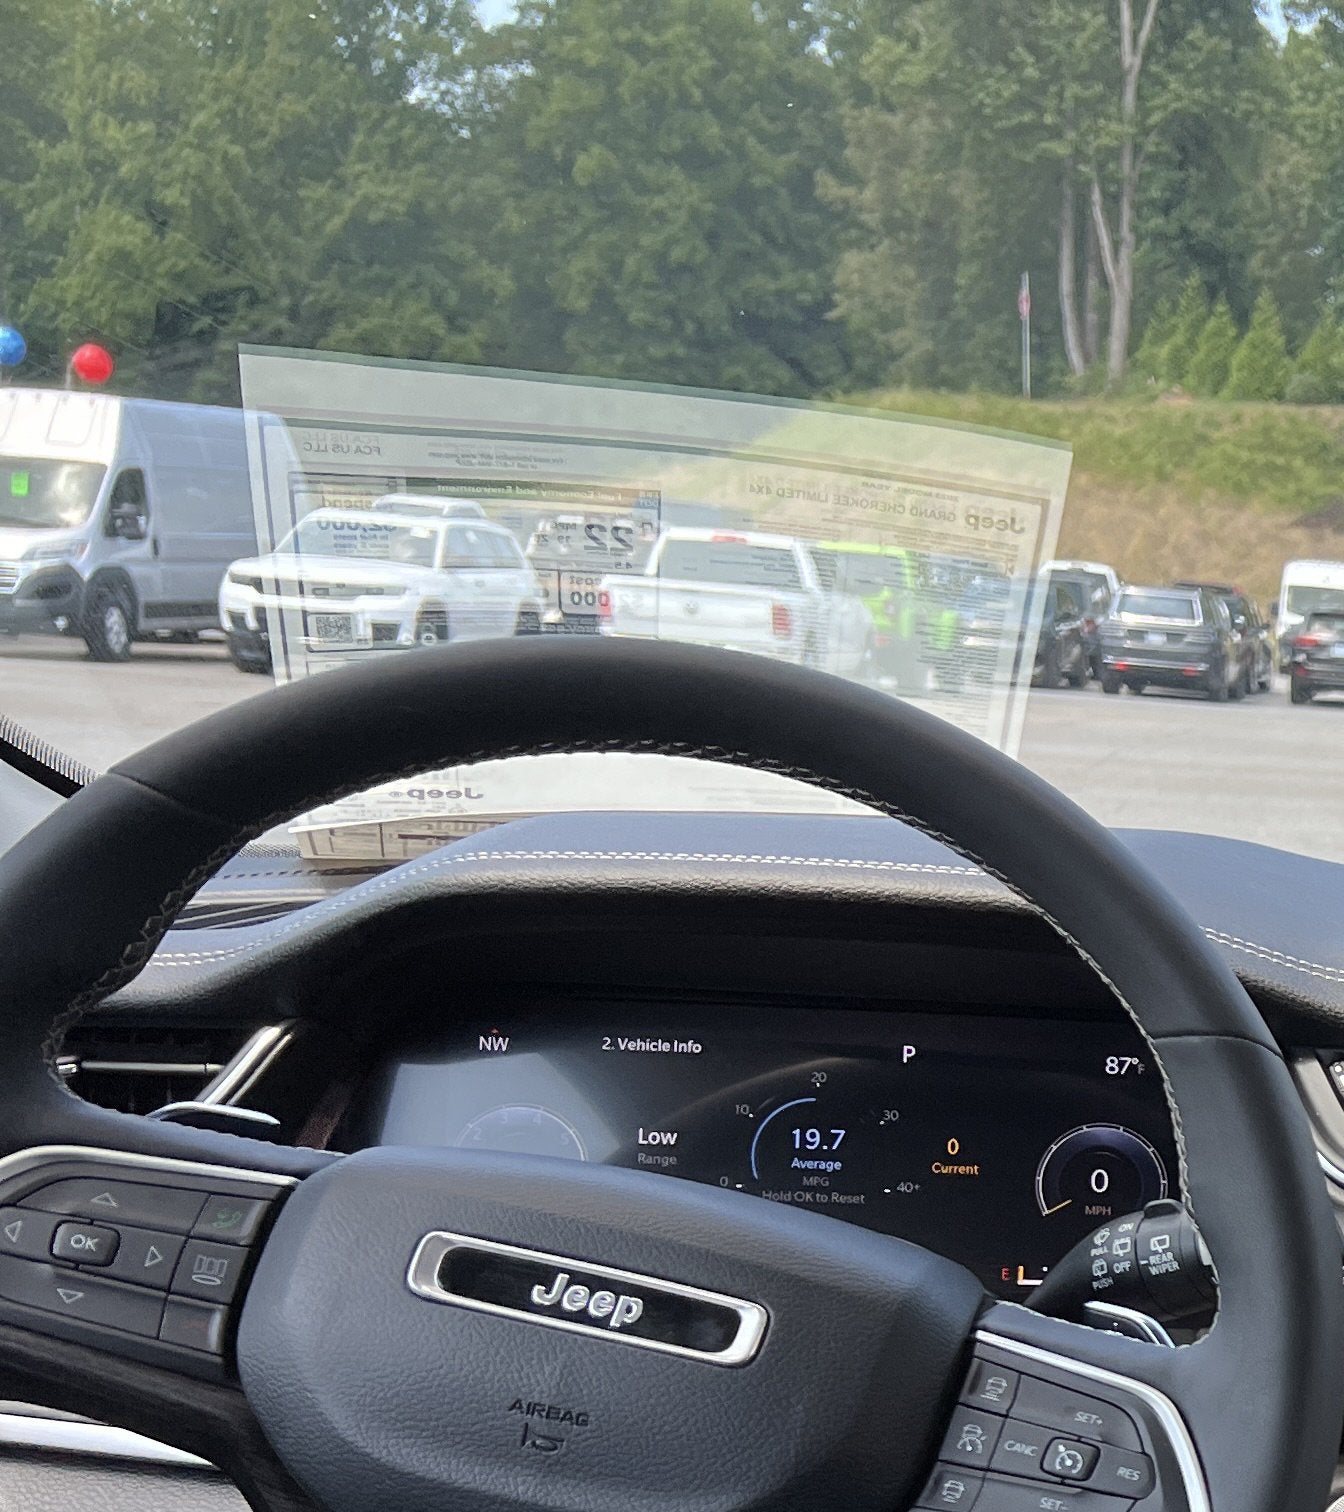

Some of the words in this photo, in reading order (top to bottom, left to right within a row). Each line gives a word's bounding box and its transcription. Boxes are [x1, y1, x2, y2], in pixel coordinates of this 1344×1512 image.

[478, 1035, 509, 1052] NW
[602, 1038, 615, 1051] 2.
[618, 1038, 670, 1053] Vehicle
[674, 1039, 702, 1053] Info
[903, 1046, 916, 1063] P
[811, 1071, 828, 1083] 20
[735, 1104, 750, 1115] 10
[883, 1109, 900, 1121] 30
[638, 1128, 678, 1146] Low
[792, 1129, 846, 1150] 19.7
[947, 1138, 959, 1154] 0
[638, 1153, 678, 1168] Range
[791, 1158, 842, 1172] Average
[932, 1162, 980, 1176] Current
[802, 1176, 830, 1188] MPG
[1091, 1169, 1109, 1193] 0
[762, 1190, 794, 1202] Hold
[795, 1191, 814, 1203] OK
[815, 1192, 828, 1203] to
[831, 1192, 866, 1204] Reset
[1085, 1205, 1112, 1216] MPH
[70, 1233, 98, 1252] OK
[1148, 1251, 1175, 1266] REAR
[1113, 1260, 1132, 1274] OFF
[1148, 1260, 1180, 1276] WIPER
[1092, 1276, 1114, 1291] PUSH
[530, 1273, 645, 1328] Jeep
[508, 1398, 590, 1427] AIRBAG
[1074, 1410, 1104, 1427] SET+
[1004, 1439, 1038, 1457] CANC
[1116, 1466, 1141, 1482] RES
[1040, 1496, 1069, 1511] SET-
